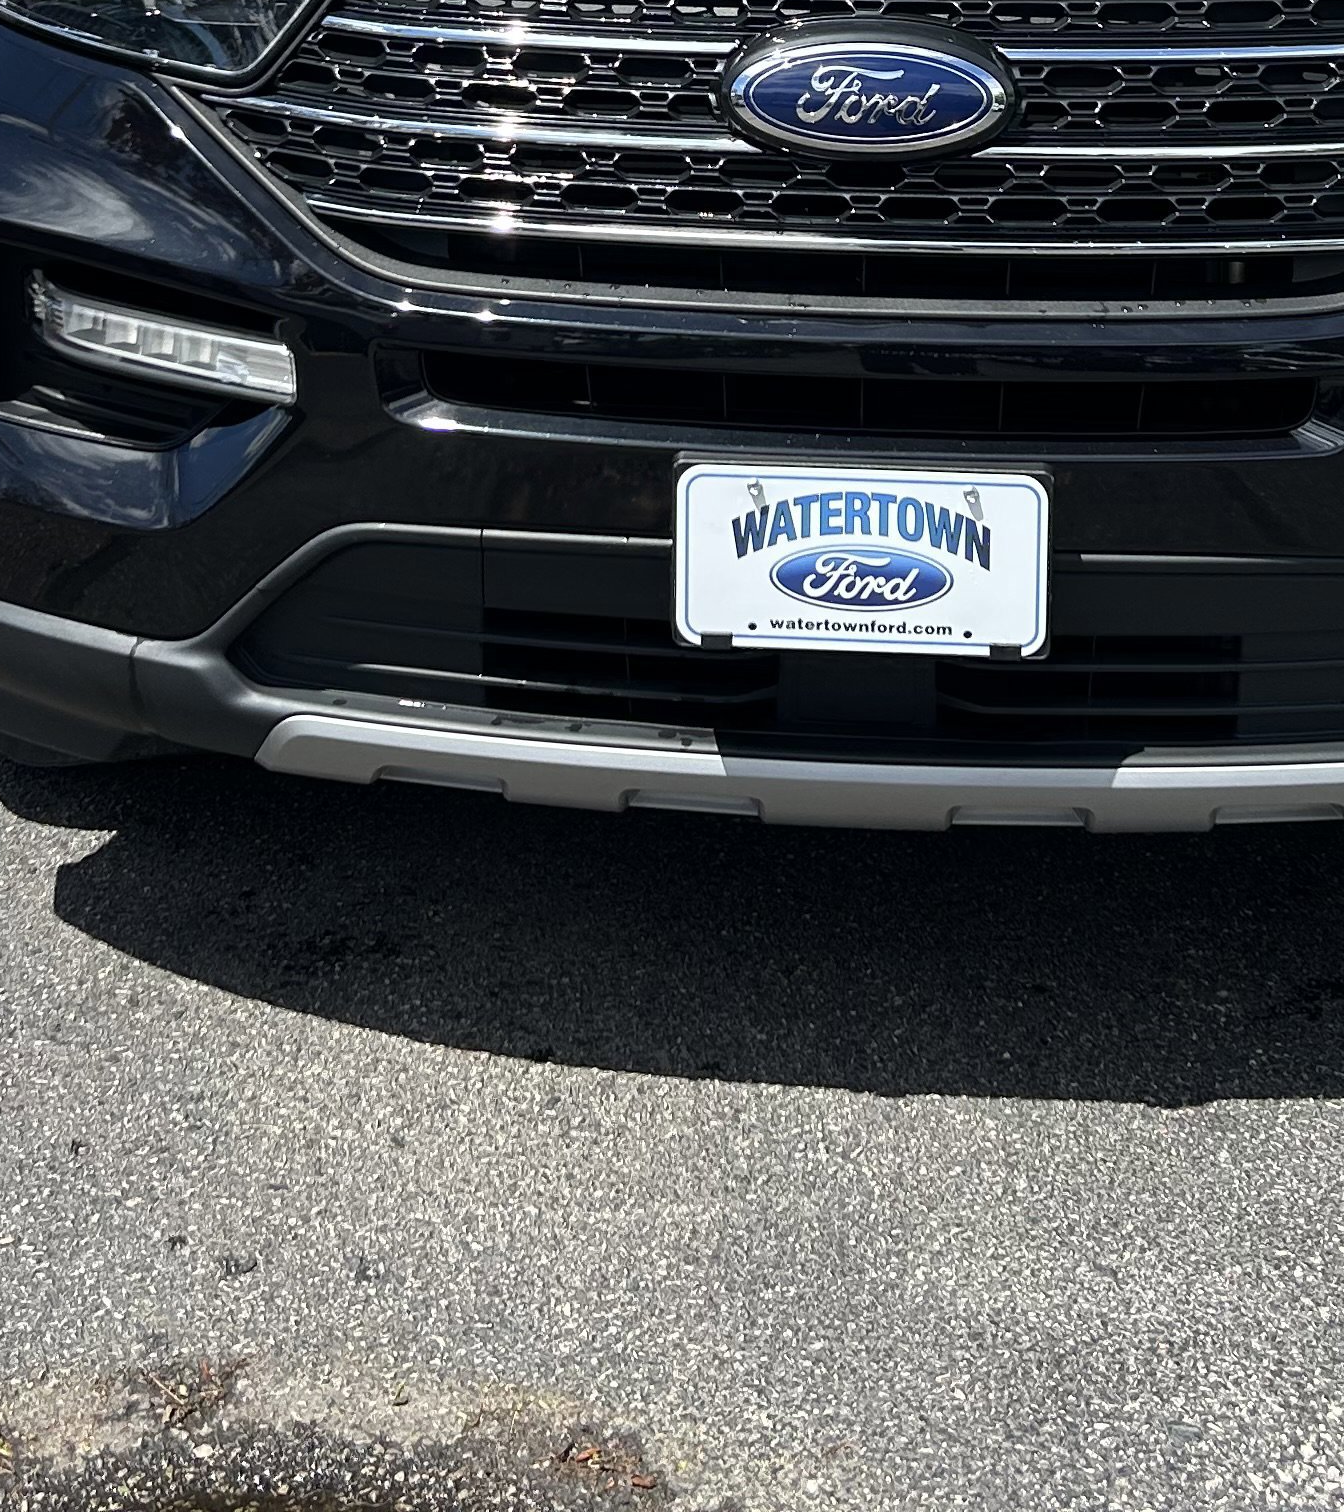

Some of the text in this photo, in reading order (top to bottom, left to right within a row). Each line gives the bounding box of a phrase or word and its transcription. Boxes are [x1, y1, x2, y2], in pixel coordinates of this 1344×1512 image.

[796, 65, 940, 125] Ford
[731, 491, 991, 572] WATERTOWN
[802, 553, 920, 602] Ford
[770, 618, 954, 637] watertownford.com
